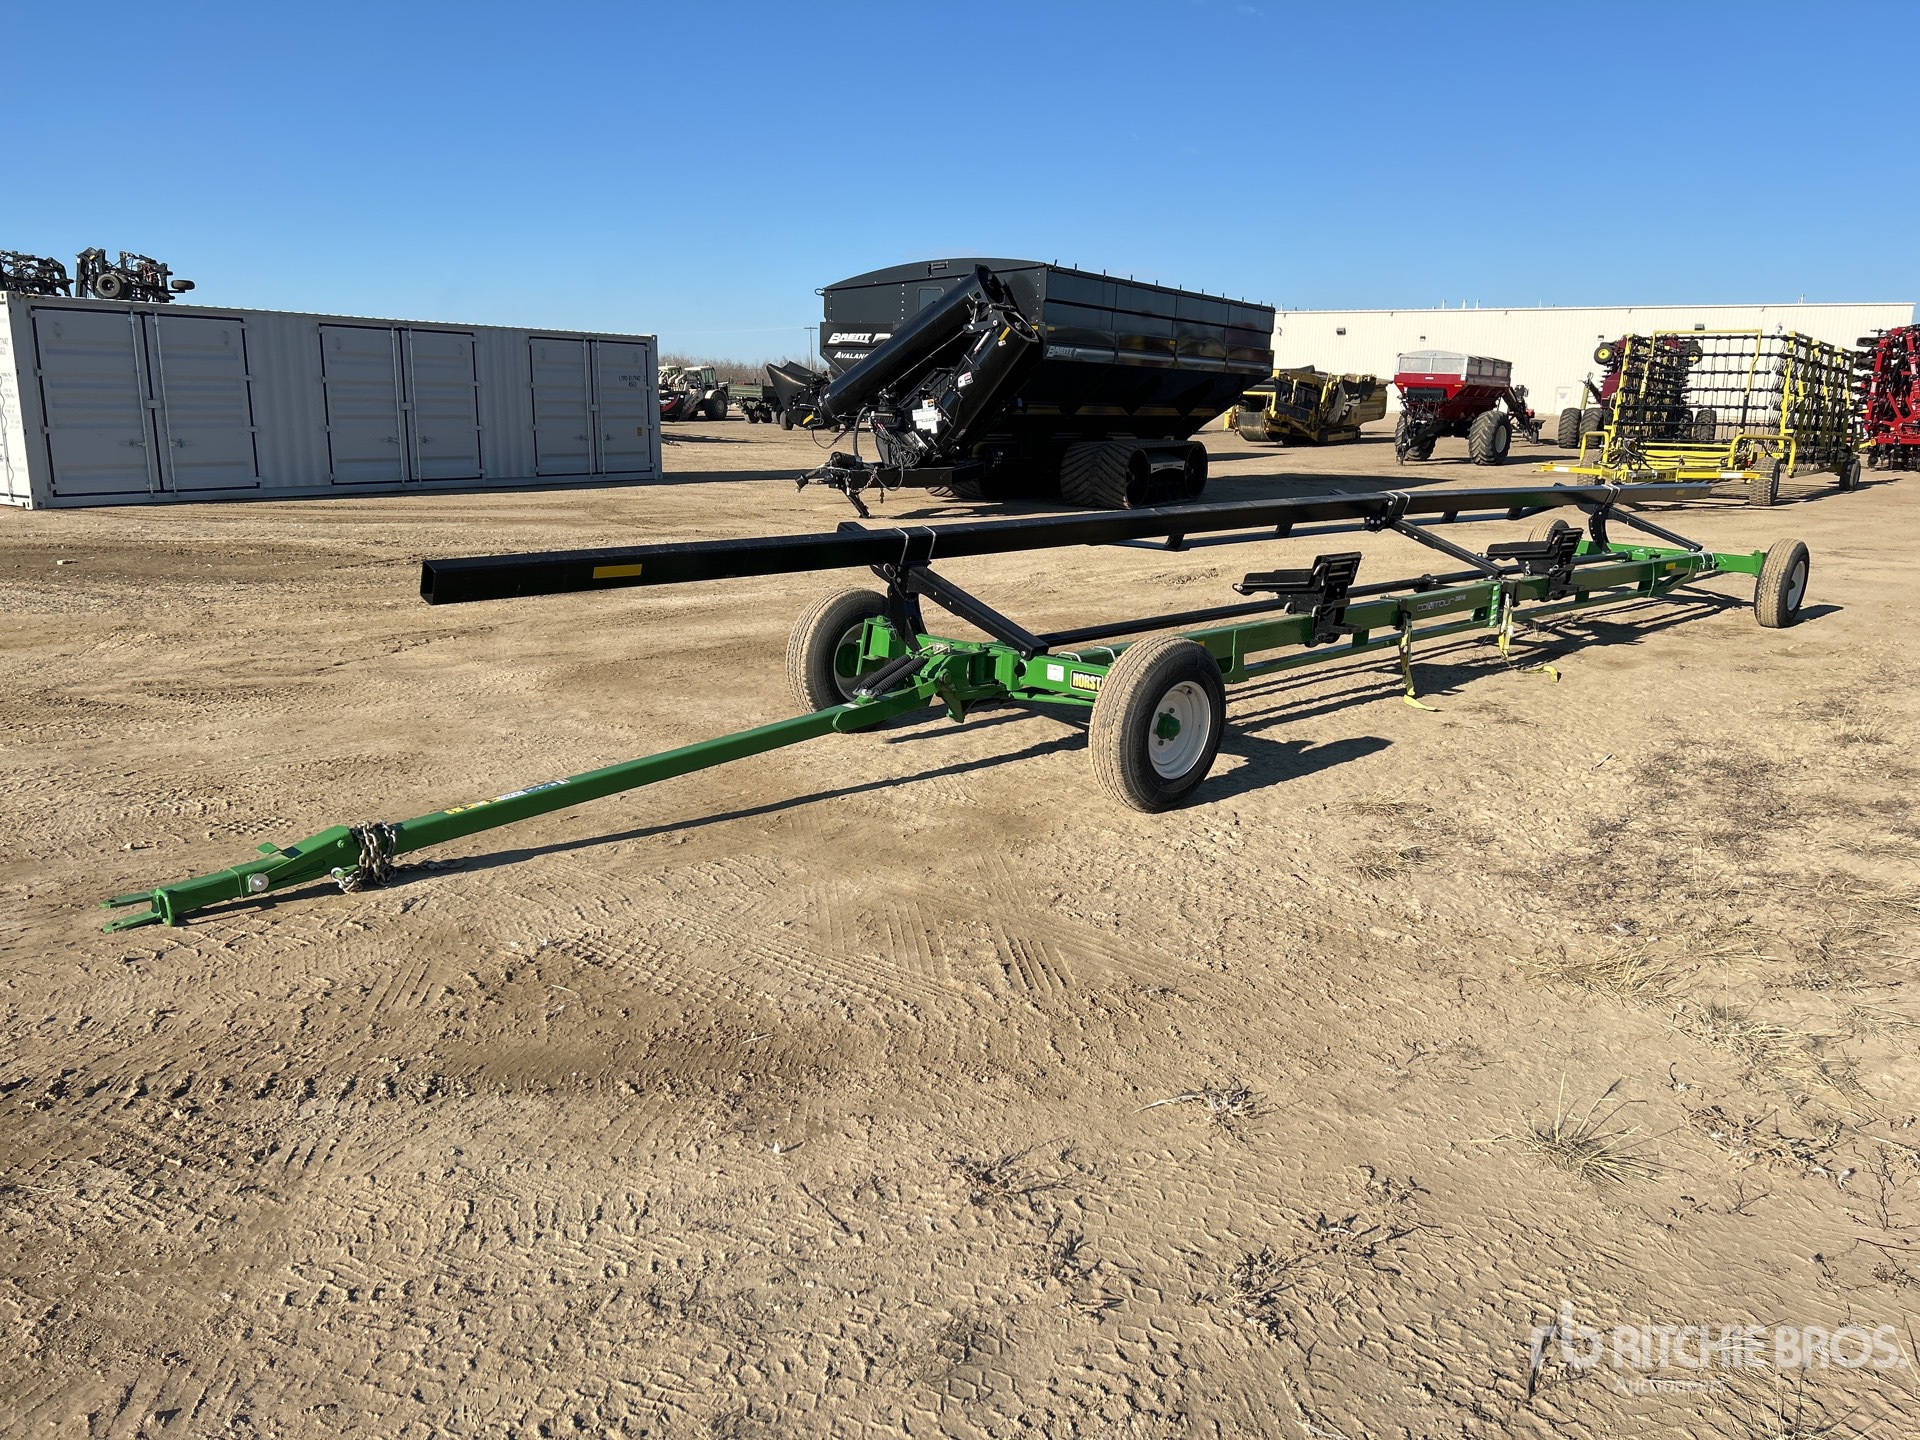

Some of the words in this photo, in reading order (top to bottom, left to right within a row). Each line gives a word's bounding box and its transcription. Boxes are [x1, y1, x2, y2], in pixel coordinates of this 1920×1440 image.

[827, 332, 872, 344] BRENT
[1046, 345, 1074, 357] BRENT
[1072, 672, 1102, 690] HORST
